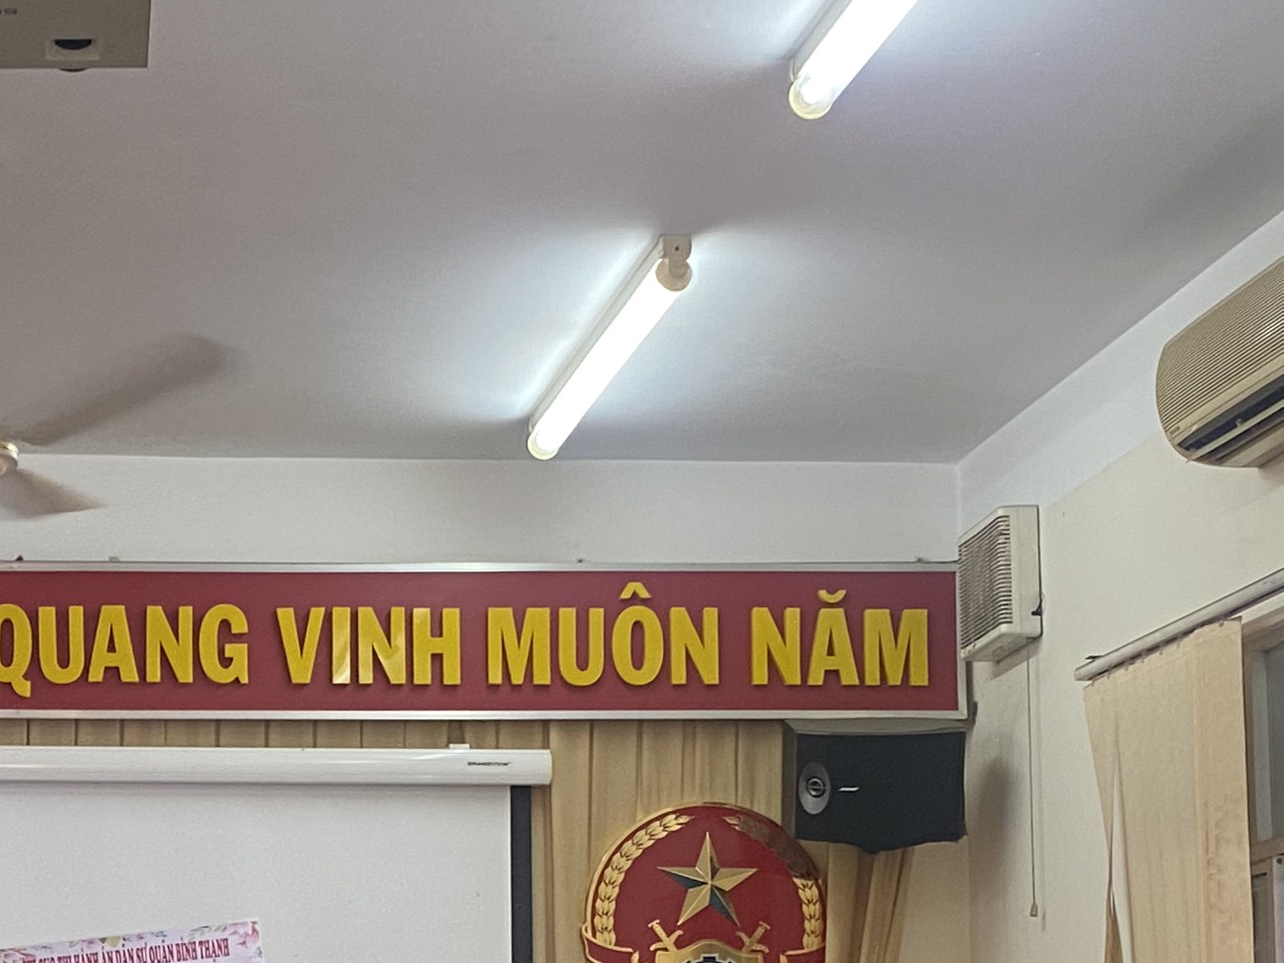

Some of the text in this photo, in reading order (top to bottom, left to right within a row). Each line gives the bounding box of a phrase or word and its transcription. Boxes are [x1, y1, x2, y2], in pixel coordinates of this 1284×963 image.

[277, 605, 464, 687] VINH
[487, 582, 721, 686] MUÔN
[749, 587, 930, 688] NĂM
[198, 937, 231, 963] THẠNH
